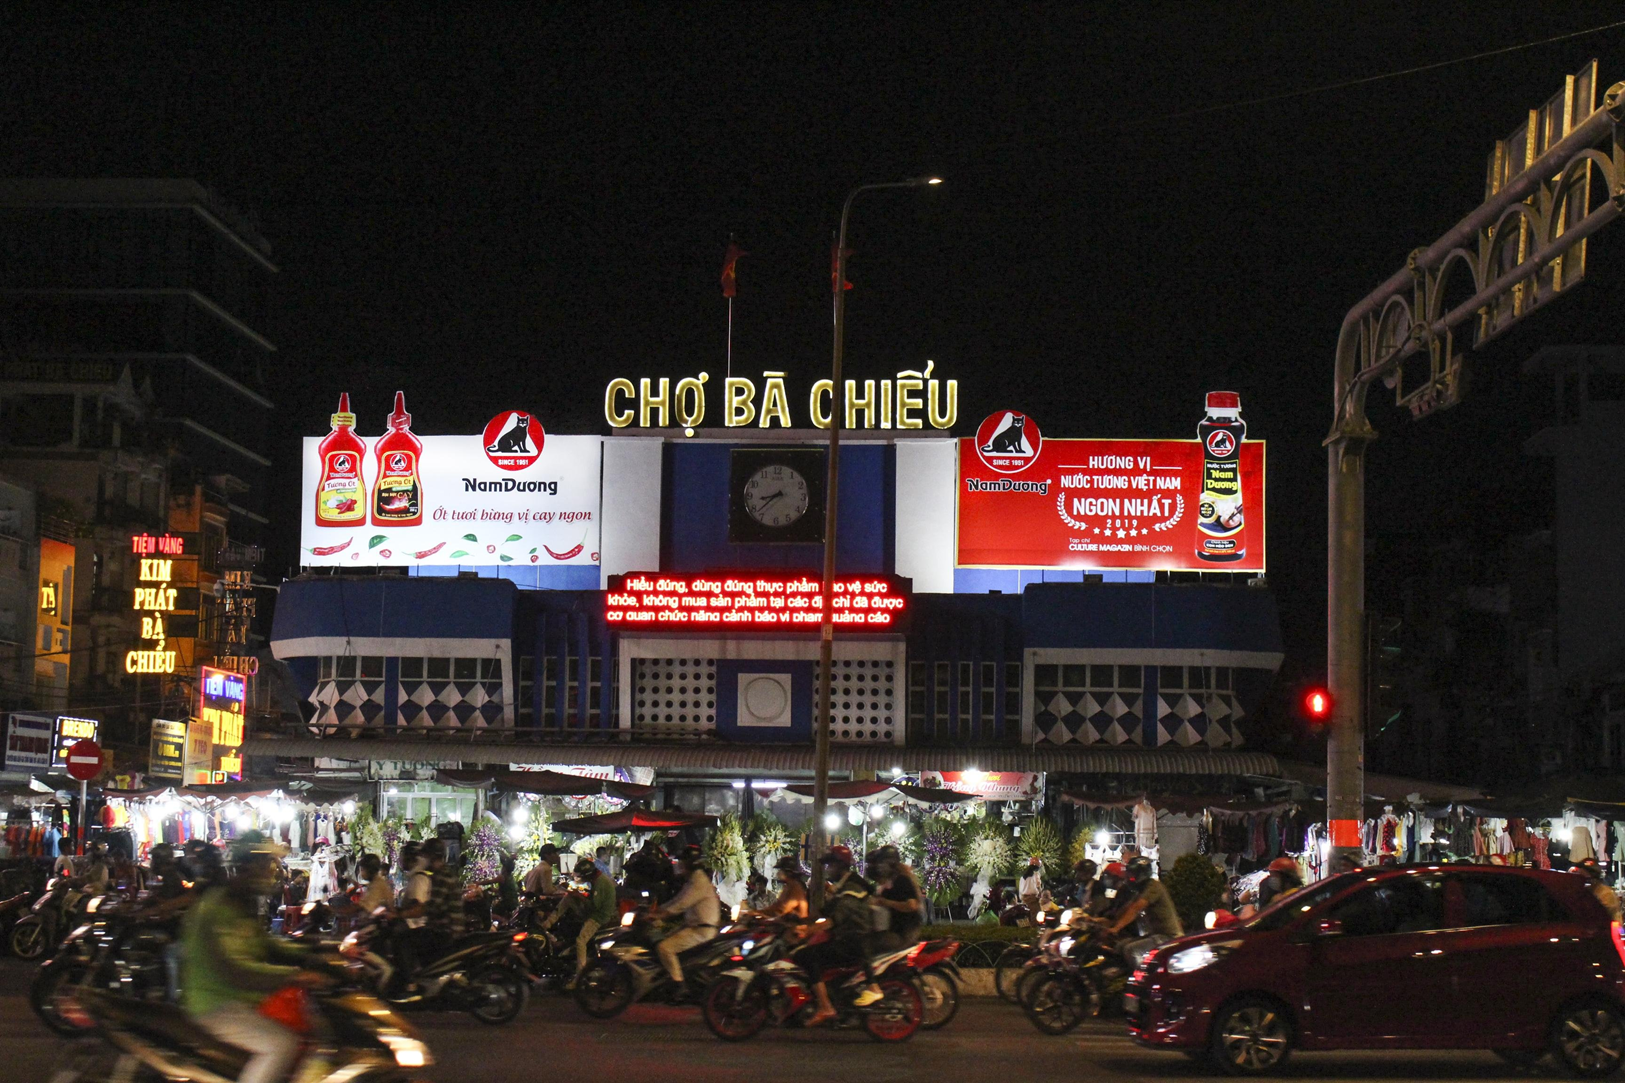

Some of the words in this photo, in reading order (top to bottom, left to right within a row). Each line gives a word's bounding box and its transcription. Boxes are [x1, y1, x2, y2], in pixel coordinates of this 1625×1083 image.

[604, 371, 709, 438] CHỢ
[773, 466, 783, 475] 12
[1089, 455, 1134, 469] HƯƠNG
[1137, 456, 1151, 472] VỊ
[1060, 472, 1091, 489] NƯỚC
[1092, 474, 1129, 489] TƯƠNG
[1130, 473, 1155, 492] VIỆT
[1156, 476, 1181, 490] NAM
[1210, 469, 1234, 479] Nam
[397, 491, 414, 499] CAY
[1073, 497, 1120, 516] NGON
[1123, 493, 1172, 517] NHẤT
[451, 508, 477, 521] tươi
[480, 508, 514, 524] bừng
[517, 508, 530, 524] vị
[532, 511, 556, 524] cay
[558, 510, 592, 524] ngon
[132, 533, 156, 557] TIỆM
[158, 533, 184, 555] VÀNG
[1068, 543, 1098, 551] CULTURE
[1099, 544, 1133, 552] MAGAZIN
[1133, 543, 1150, 552] BÌNH
[1150, 545, 1173, 553] CHỌN
[139, 558, 173, 581] KIM
[626, 576, 654, 591] Hiểu
[656, 579, 689, 594] đúng,
[692, 580, 721, 594] dùng
[724, 580, 754, 594] đúng
[756, 580, 784, 594] thực
[847, 580, 862, 594] vệ
[864, 581, 888, 593] sức
[133, 582, 178, 611] PHÁT
[643, 595, 679, 608] không
[681, 597, 707, 606] mua
[709, 594, 732, 607] sản
[734, 593, 767, 609] phẩm
[770, 595, 785, 609] tại
[787, 595, 809, 607] các
[871, 596, 904, 610] được
[607, 611, 623, 621] cơ
[658, 609, 688, 621] chức
[722, 608, 752, 621] cảnh
[754, 610, 777, 622] báo
[867, 611, 890, 623] cáo
[141, 611, 165, 640] BÀ
